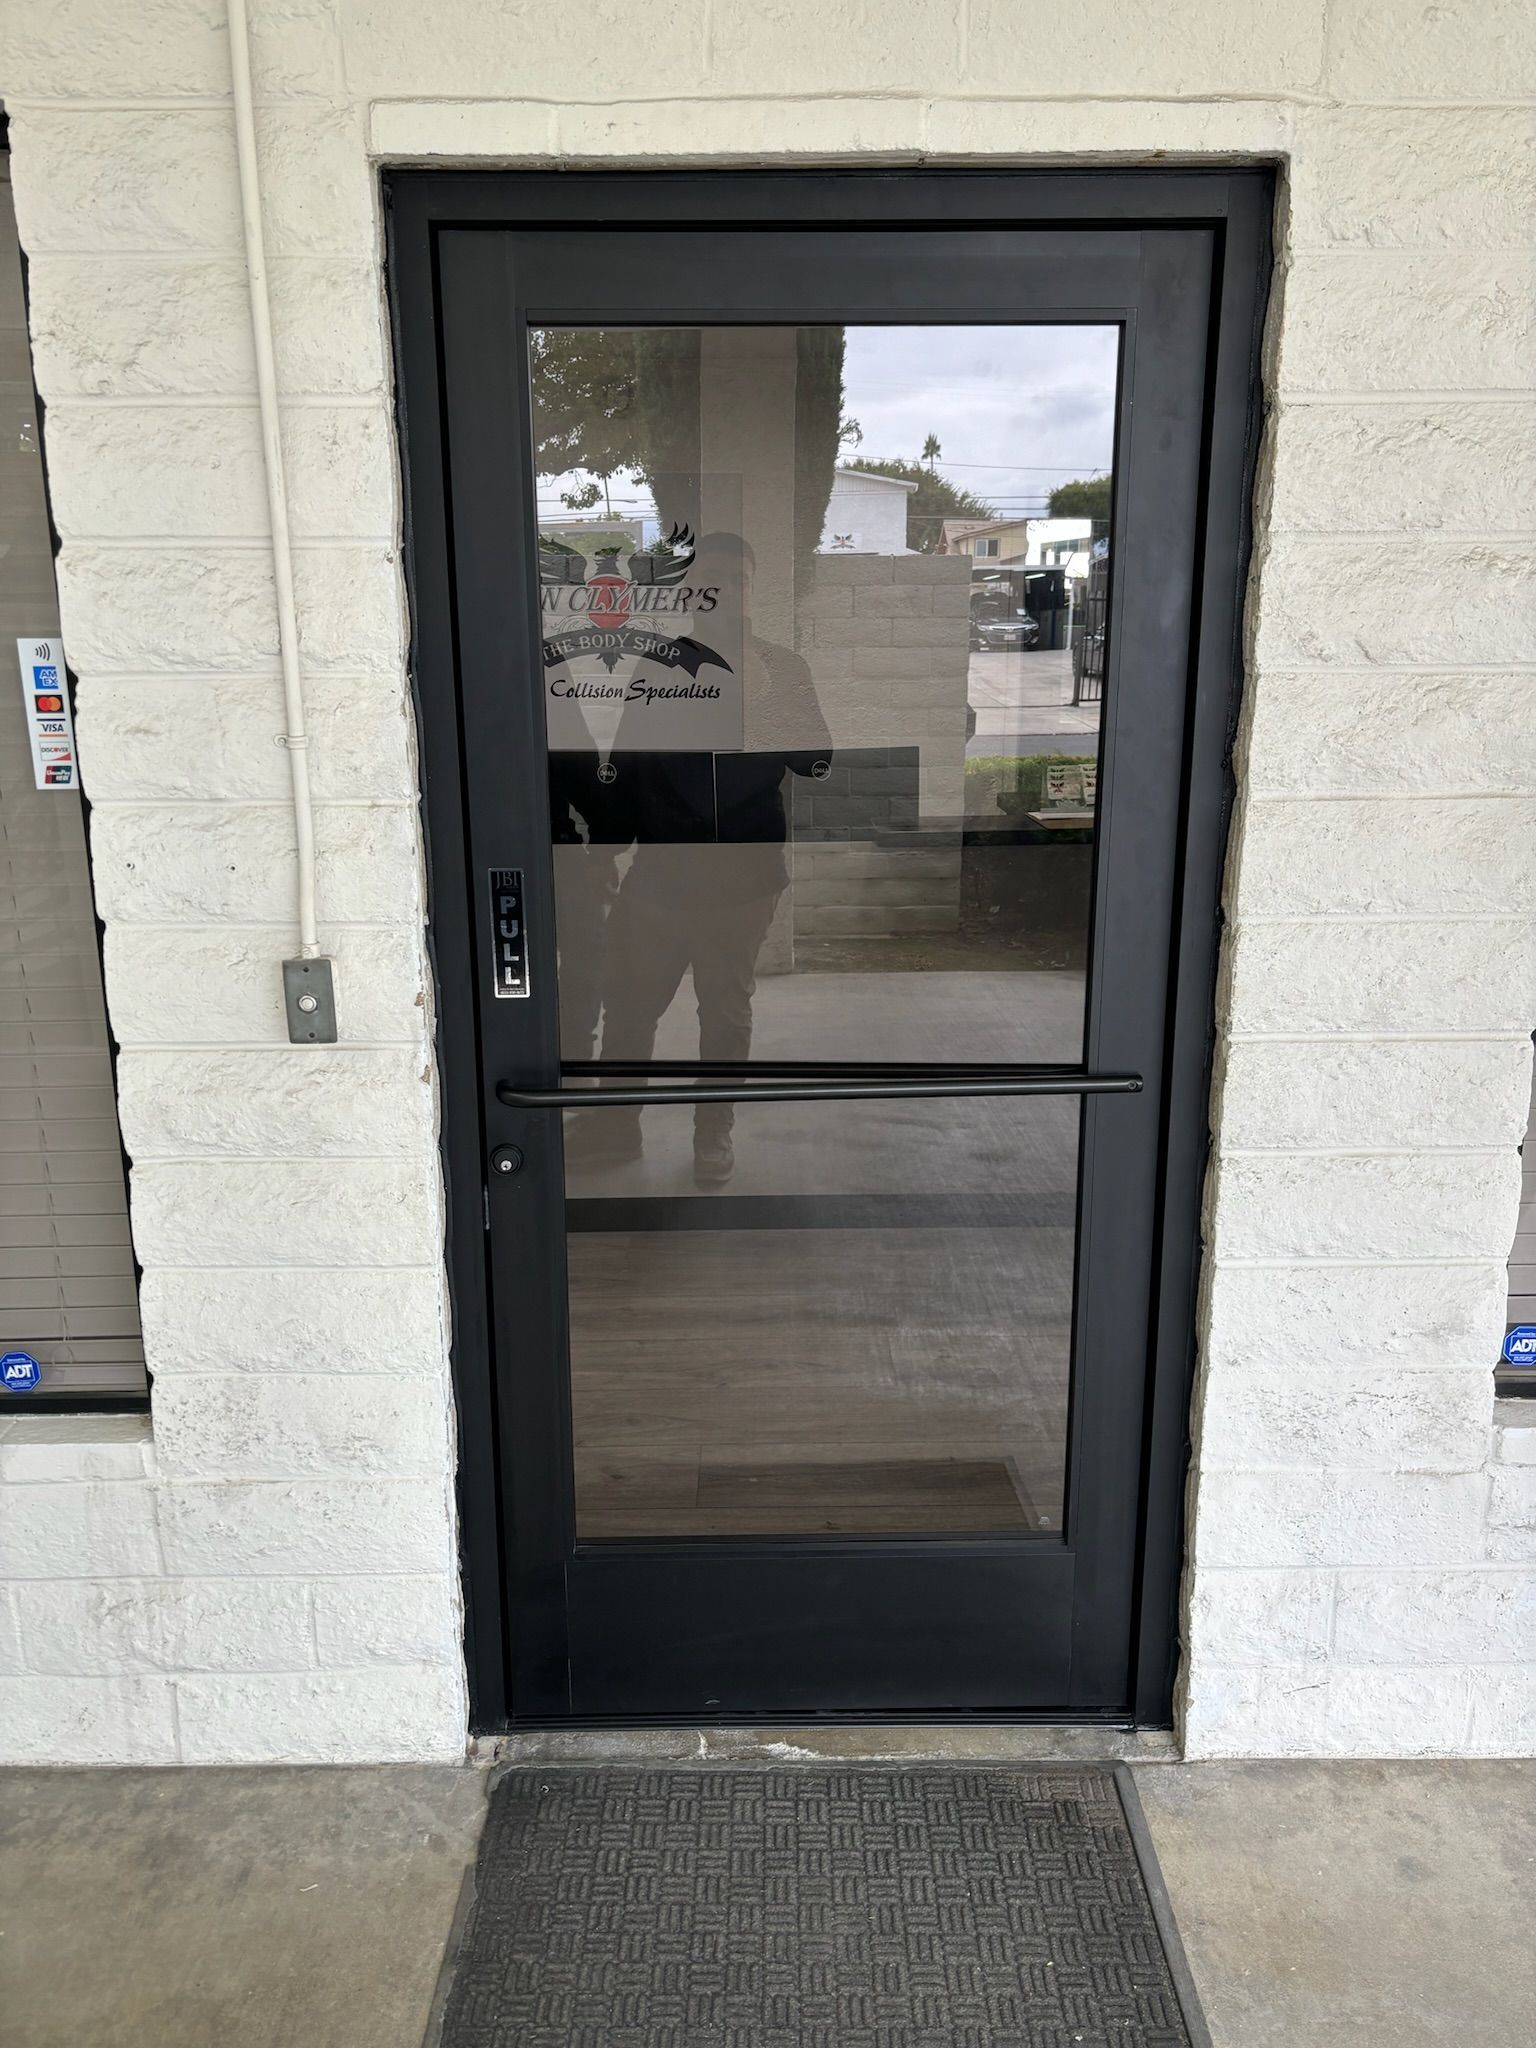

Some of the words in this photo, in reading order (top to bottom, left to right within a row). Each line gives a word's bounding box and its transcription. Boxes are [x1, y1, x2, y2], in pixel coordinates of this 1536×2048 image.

[569, 580, 721, 613] CLYMER'S
[543, 639, 575, 660] THE
[579, 633, 630, 649] BODY
[633, 636, 681, 660] SHOP
[550, 679, 623, 699] Collision
[624, 679, 721, 705] Specialists
[42, 723, 64, 732] VISA
[500, 895, 520, 985] PULL
[6, 1364, 32, 1379] ADT
